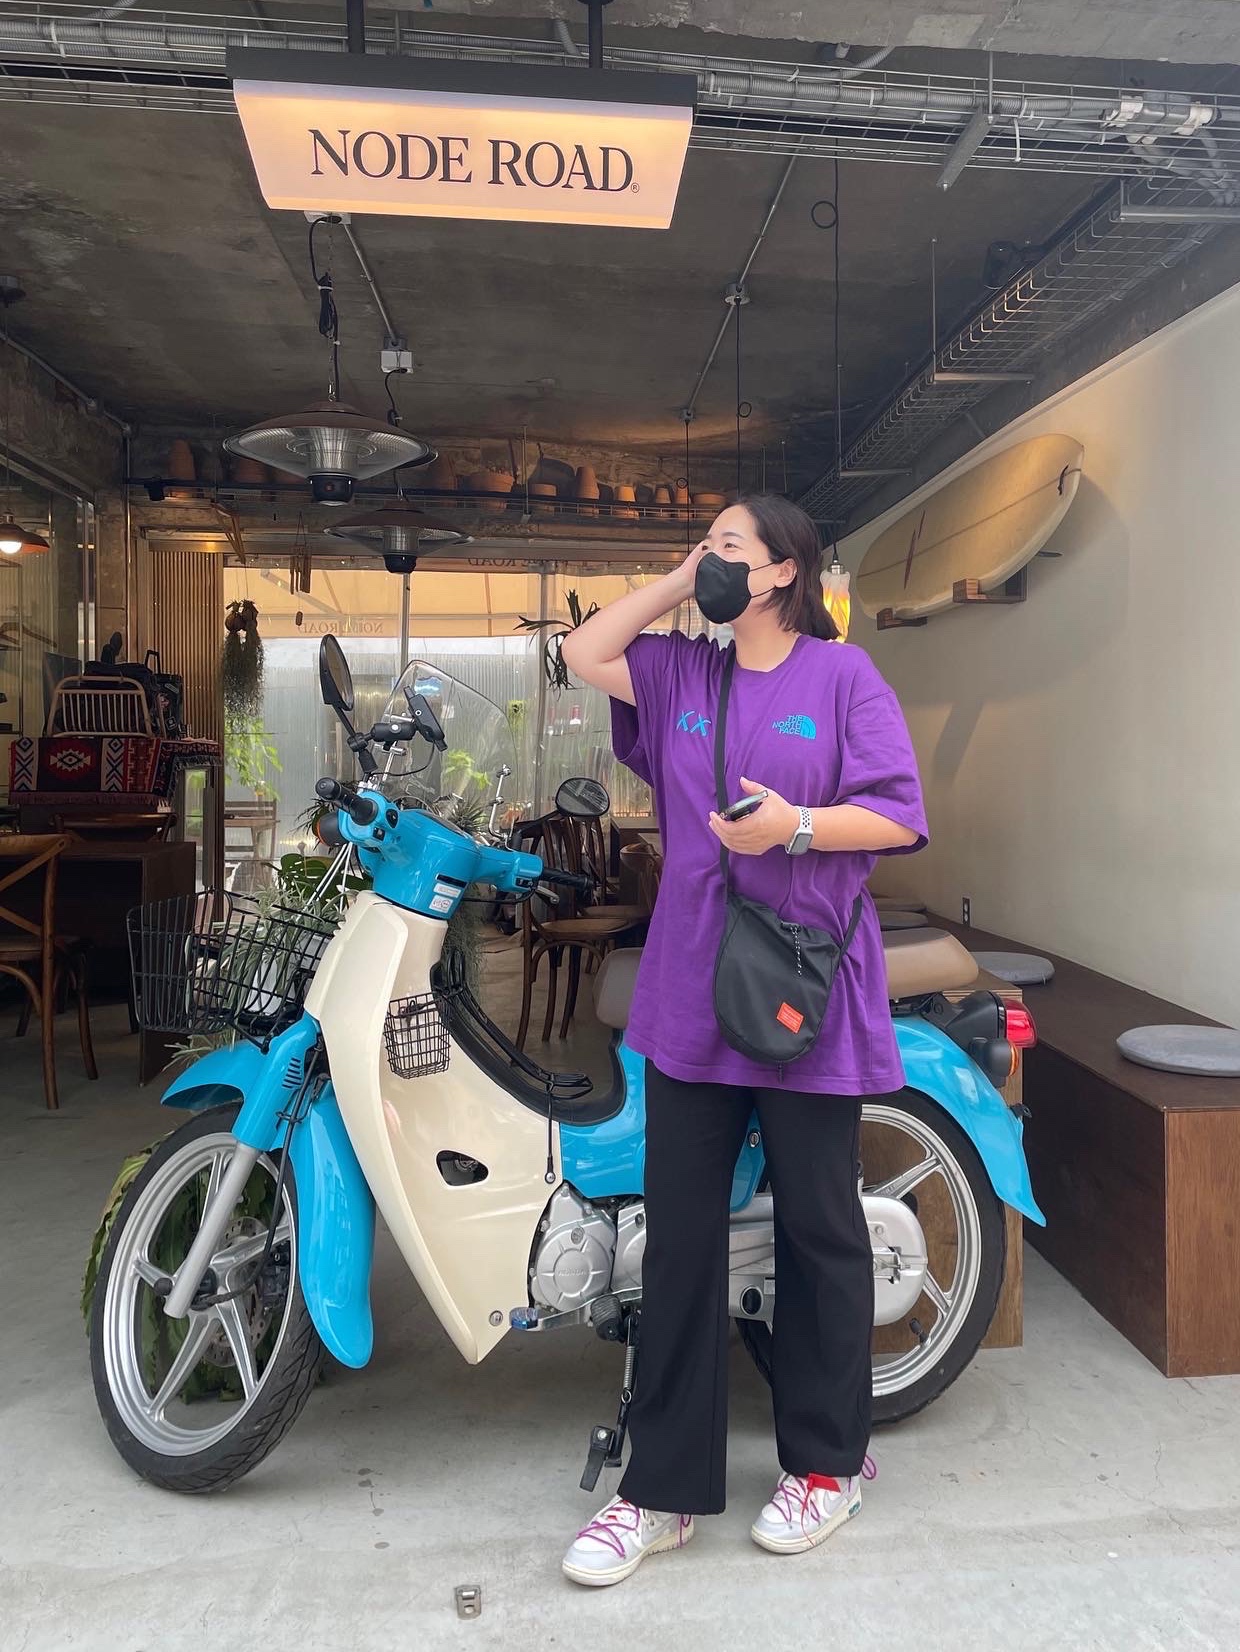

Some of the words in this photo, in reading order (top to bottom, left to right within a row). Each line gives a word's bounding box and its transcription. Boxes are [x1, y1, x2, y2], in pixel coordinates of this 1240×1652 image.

[308, 129, 473, 184] NODE
[772, 720, 801, 729] NORTH
[778, 727, 801, 735] FACE
